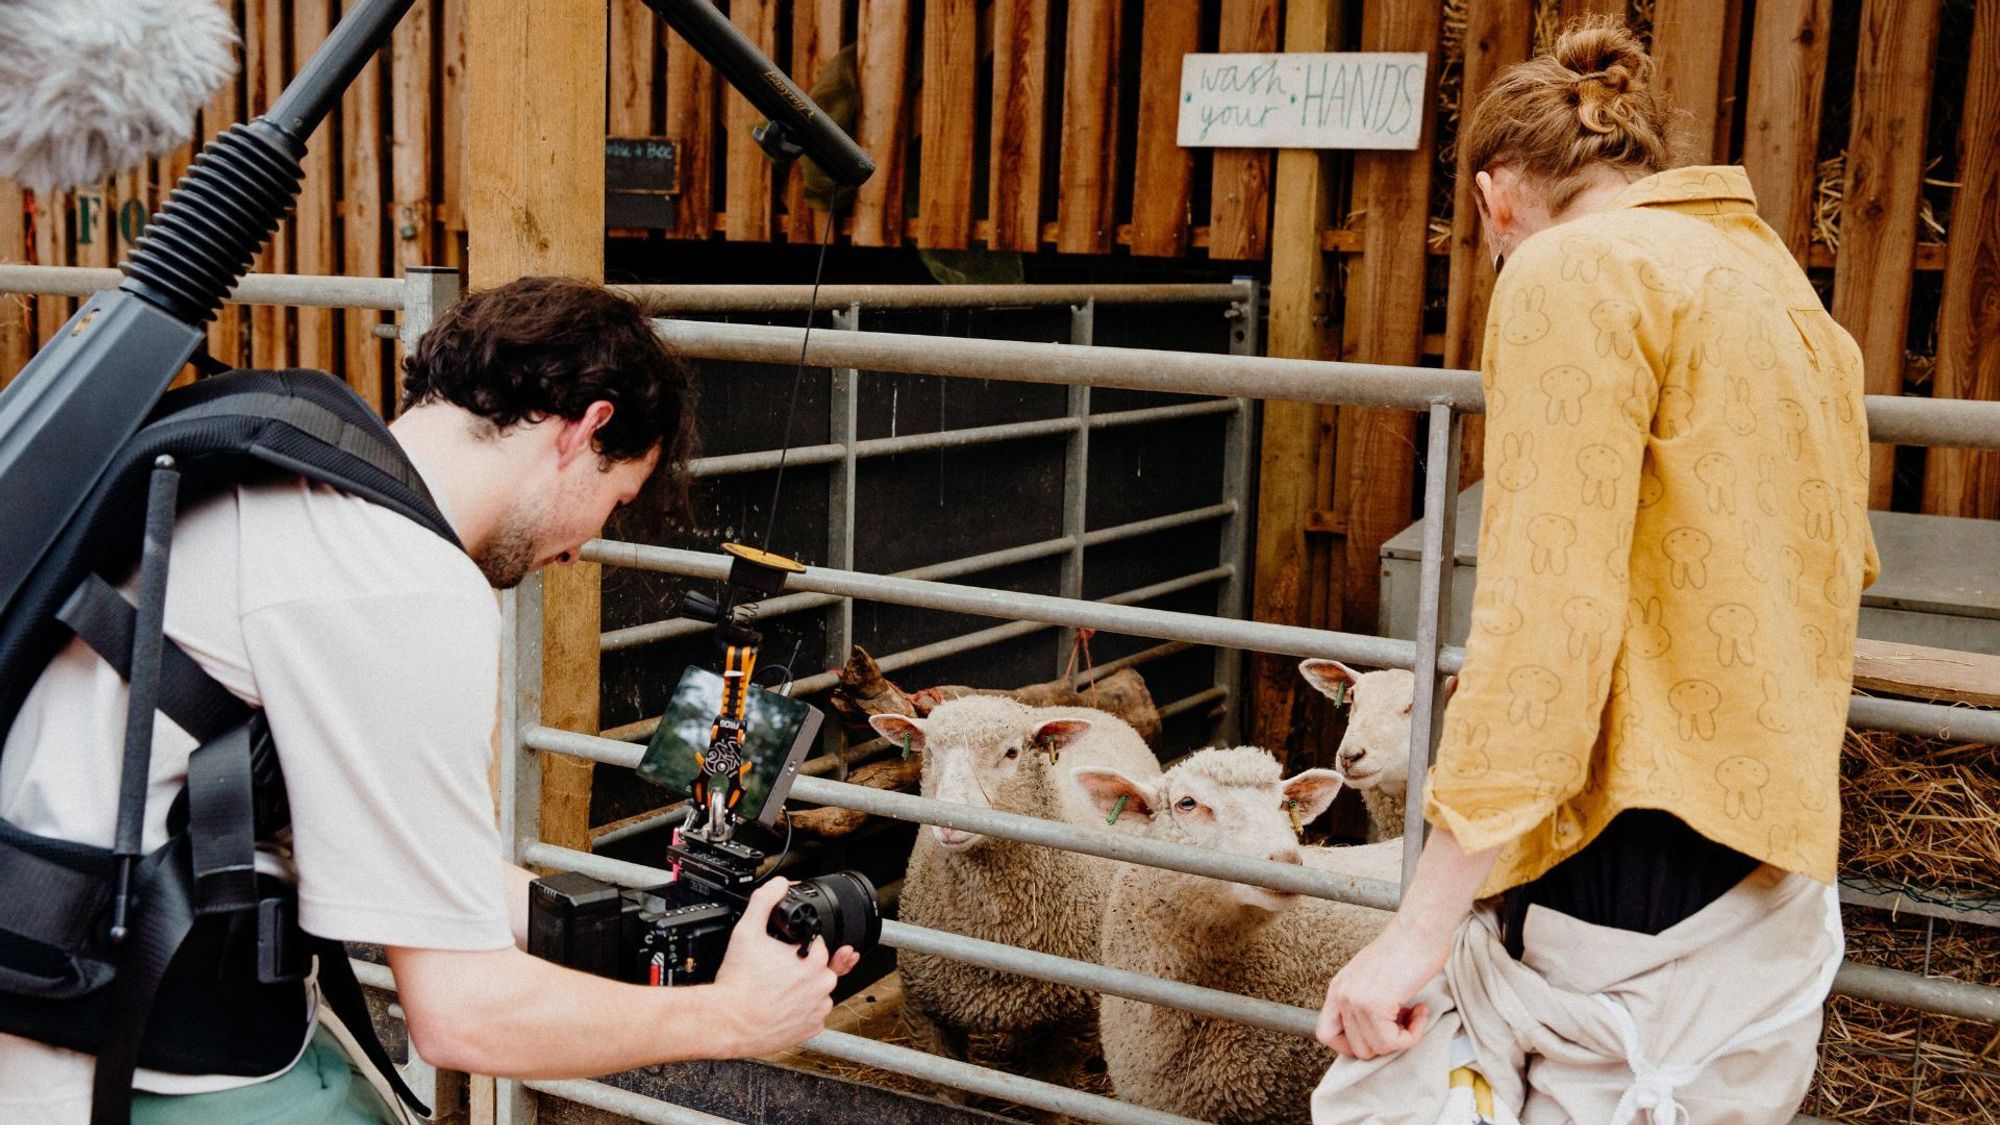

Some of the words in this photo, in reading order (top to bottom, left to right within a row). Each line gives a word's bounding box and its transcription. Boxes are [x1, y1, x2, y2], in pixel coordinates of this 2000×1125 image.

[1200, 59, 1286, 95] wash
[1301, 62, 1420, 135] HANDS
[1201, 103, 1279, 140] your
